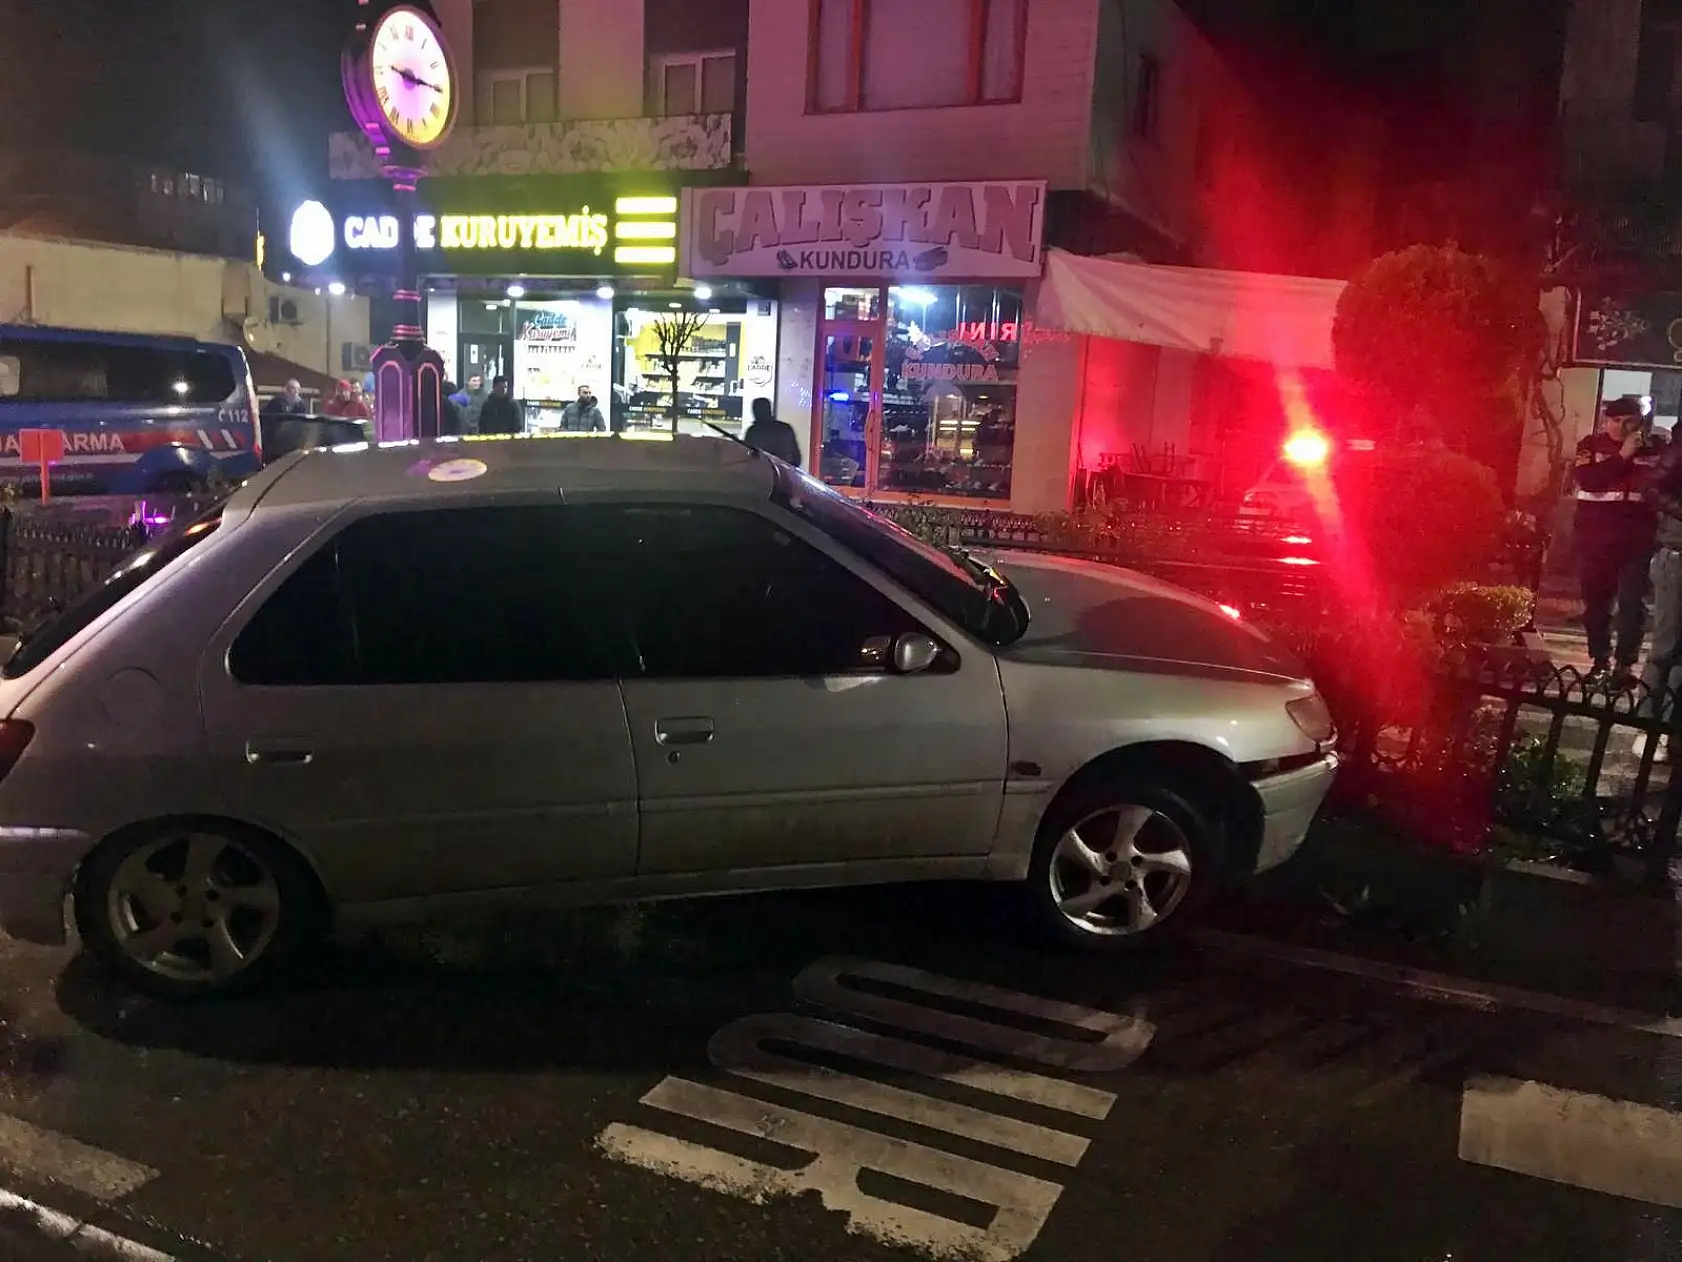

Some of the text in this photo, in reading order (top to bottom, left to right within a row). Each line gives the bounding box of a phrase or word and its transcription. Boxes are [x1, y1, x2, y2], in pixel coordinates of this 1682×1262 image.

[344, 205, 608, 256] CADE KURUYEMİŞ
[701, 185, 1038, 266] ÇALIŞKAN
[799, 250, 911, 271] KUNDURA
[901, 362, 999, 381] KUNDURA
[228, 409, 249, 423] 112
